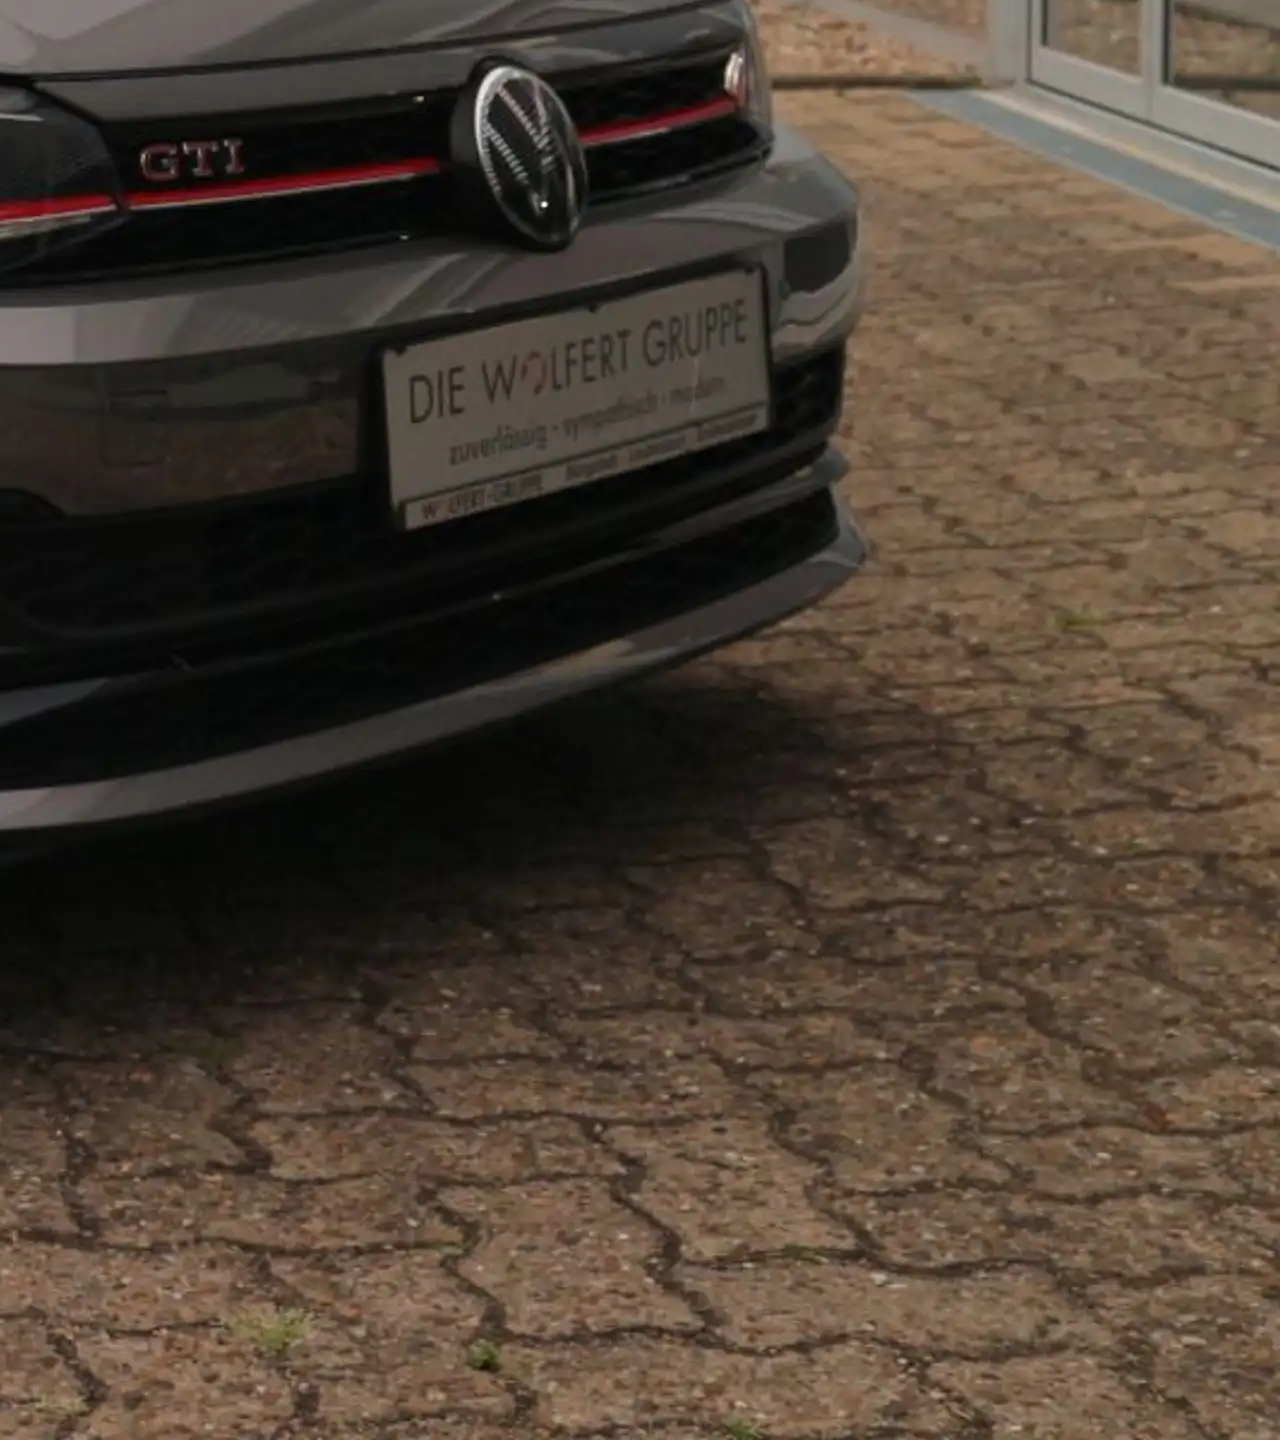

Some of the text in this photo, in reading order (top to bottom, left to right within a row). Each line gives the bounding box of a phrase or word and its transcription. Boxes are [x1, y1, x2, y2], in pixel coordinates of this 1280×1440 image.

[138, 137, 246, 183] GTI
[409, 298, 747, 425] DIE WOLFERT GRUPPE
